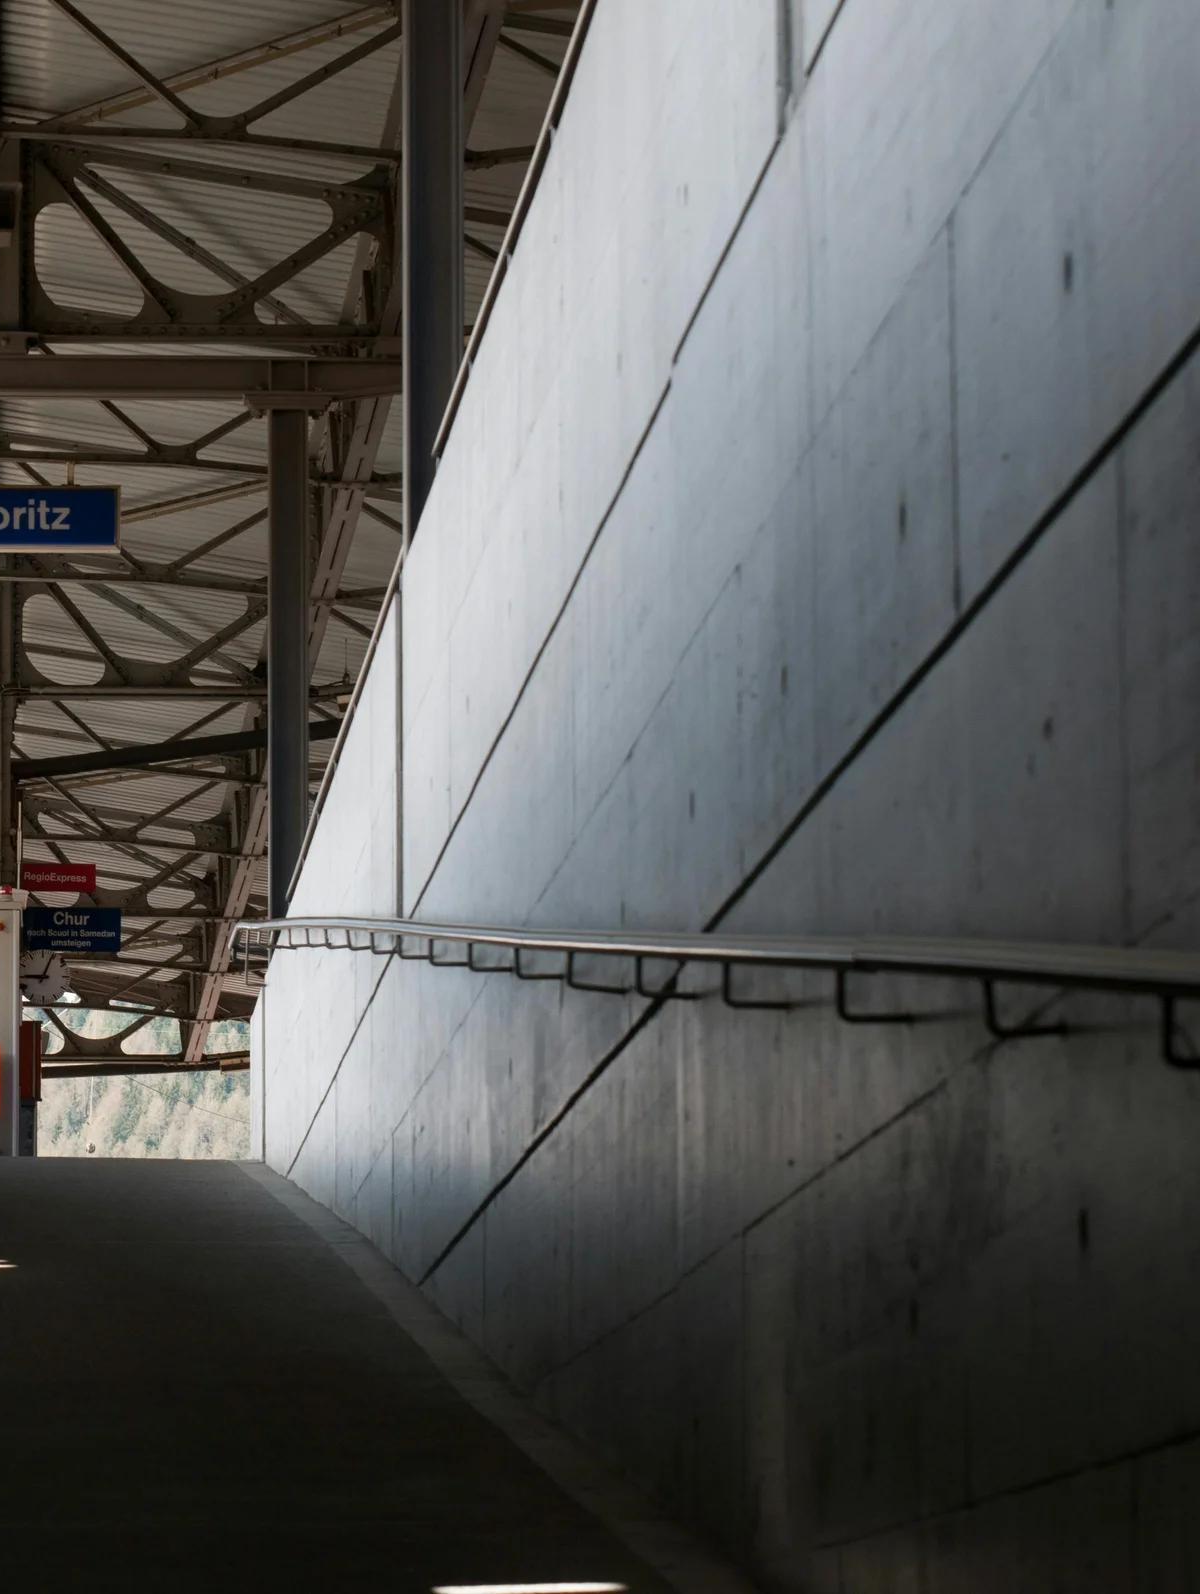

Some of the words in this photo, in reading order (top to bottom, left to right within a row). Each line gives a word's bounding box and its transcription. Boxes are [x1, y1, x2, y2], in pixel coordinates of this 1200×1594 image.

[24, 872, 87, 883] RegioExpress
[53, 911, 90, 926] Chur
[27, 929, 46, 937] nach
[47, 929, 69, 937] Scuol
[71, 929, 78, 937] in
[79, 929, 116, 938] Samedan
[51, 939, 91, 948] umsteigen
